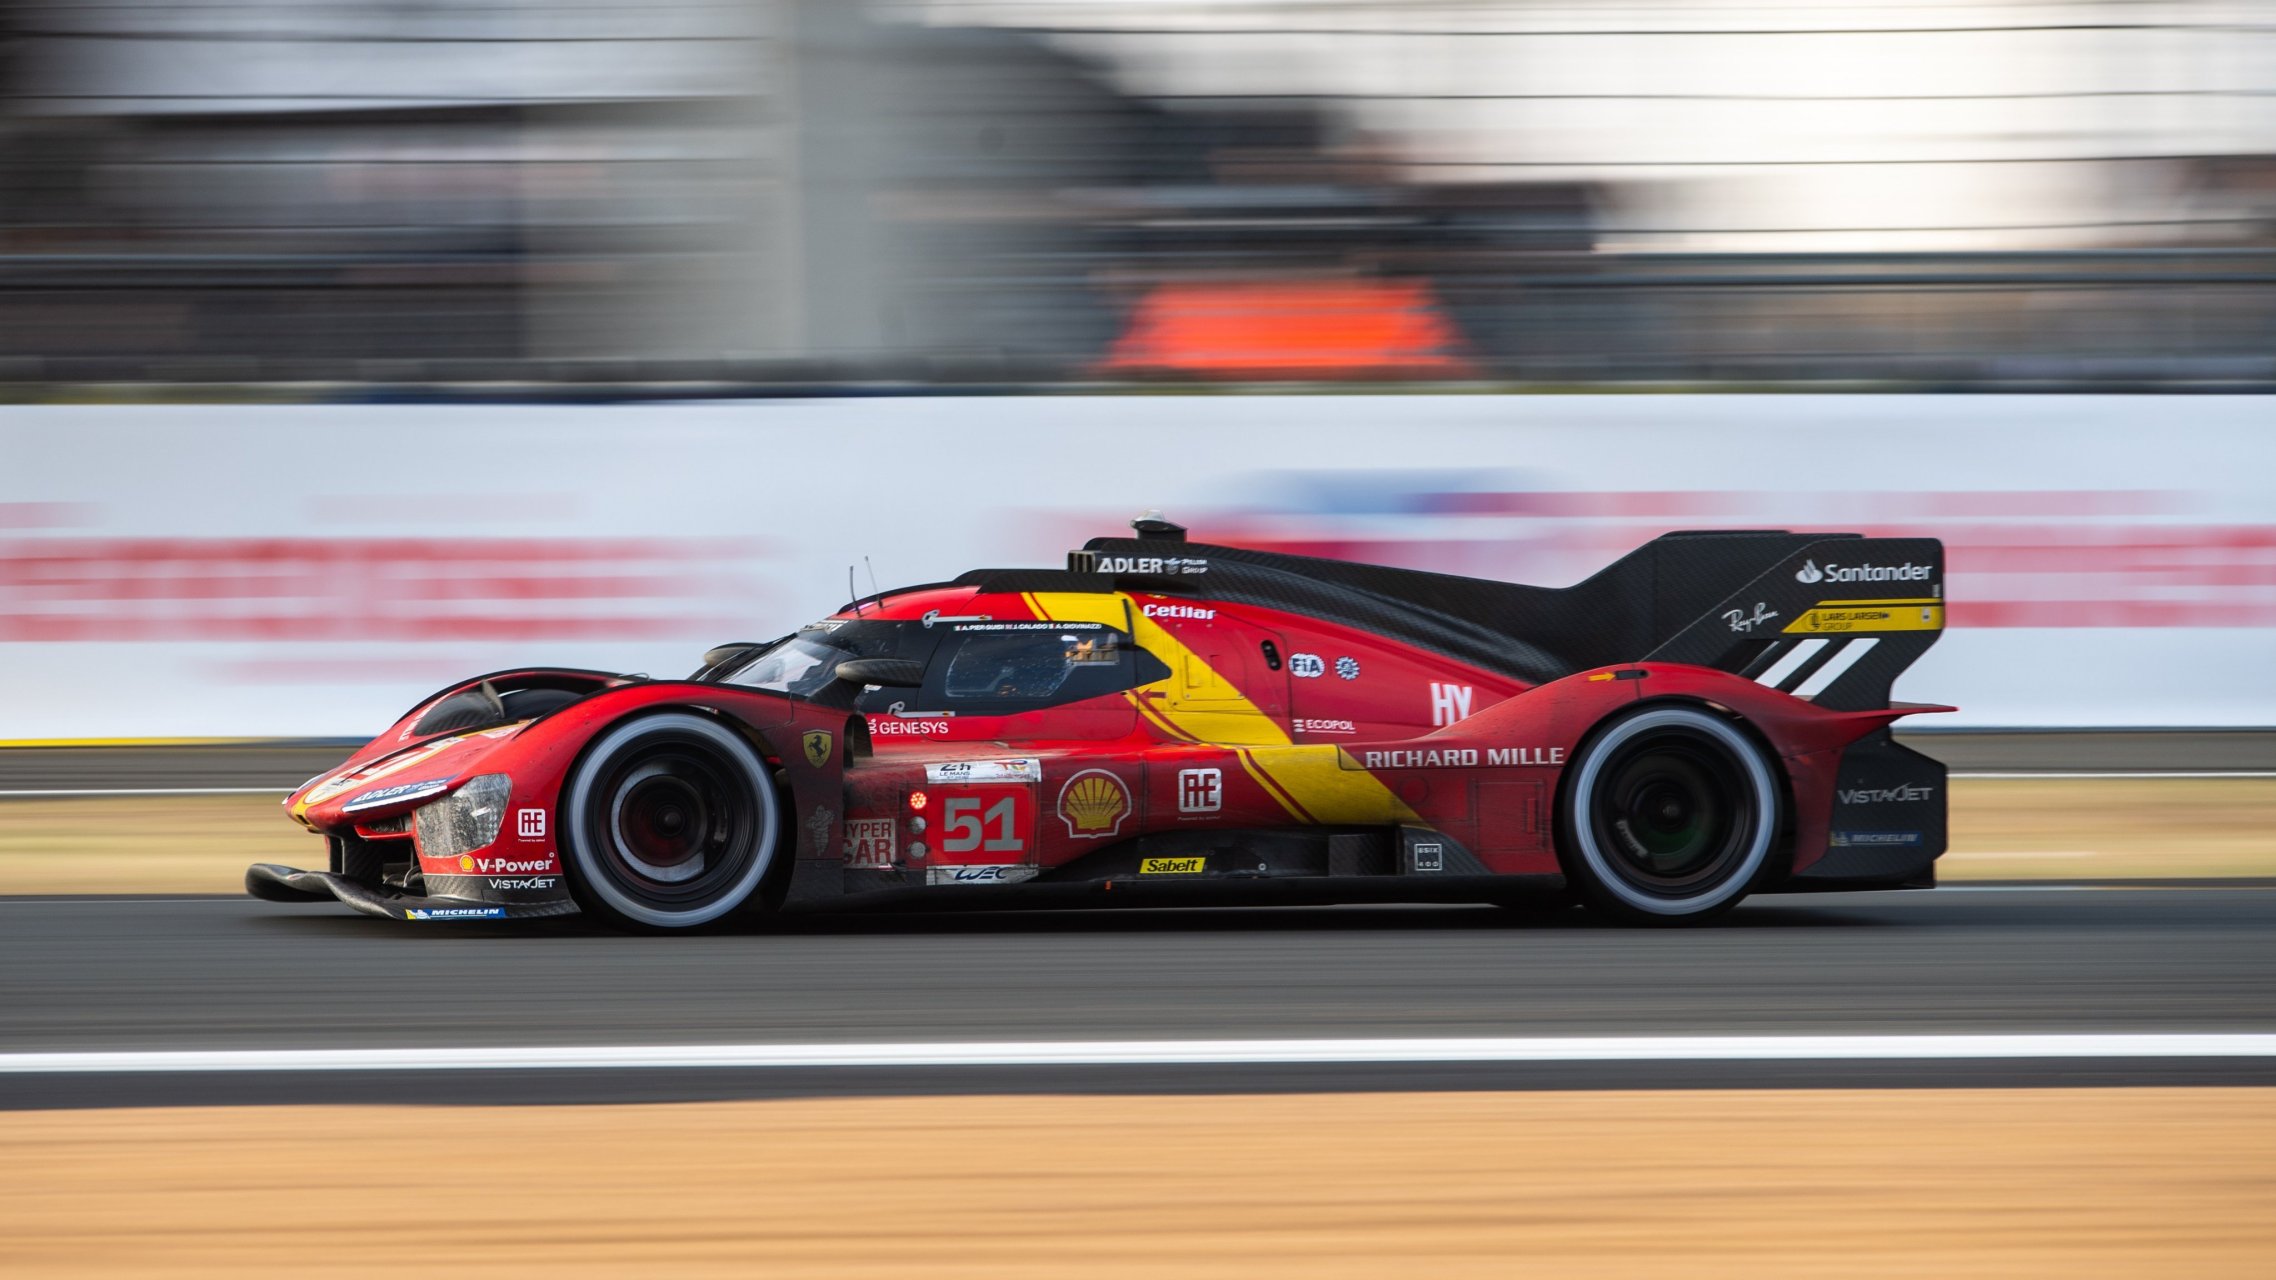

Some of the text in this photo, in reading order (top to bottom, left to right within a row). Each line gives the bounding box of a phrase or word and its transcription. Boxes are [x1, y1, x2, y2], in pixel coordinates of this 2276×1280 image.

[1096, 557, 1164, 574] ADLER
[1824, 563, 1932, 583] Santander
[1142, 603, 1216, 620] Cetilar
[1721, 602, 1779, 632] Ray-Ban
[879, 721, 949, 735] GENESYS
[1305, 719, 1356, 731] ECOPOL
[1365, 747, 1565, 768] RICHARD MILLE
[351, 785, 411, 803] ADLER
[942, 796, 1024, 852] 51
[1852, 833, 1919, 842] MICHELIN
[476, 856, 553, 874] V-Power
[1147, 858, 1198, 872] Sabelt
[955, 867, 1008, 881] WEC
